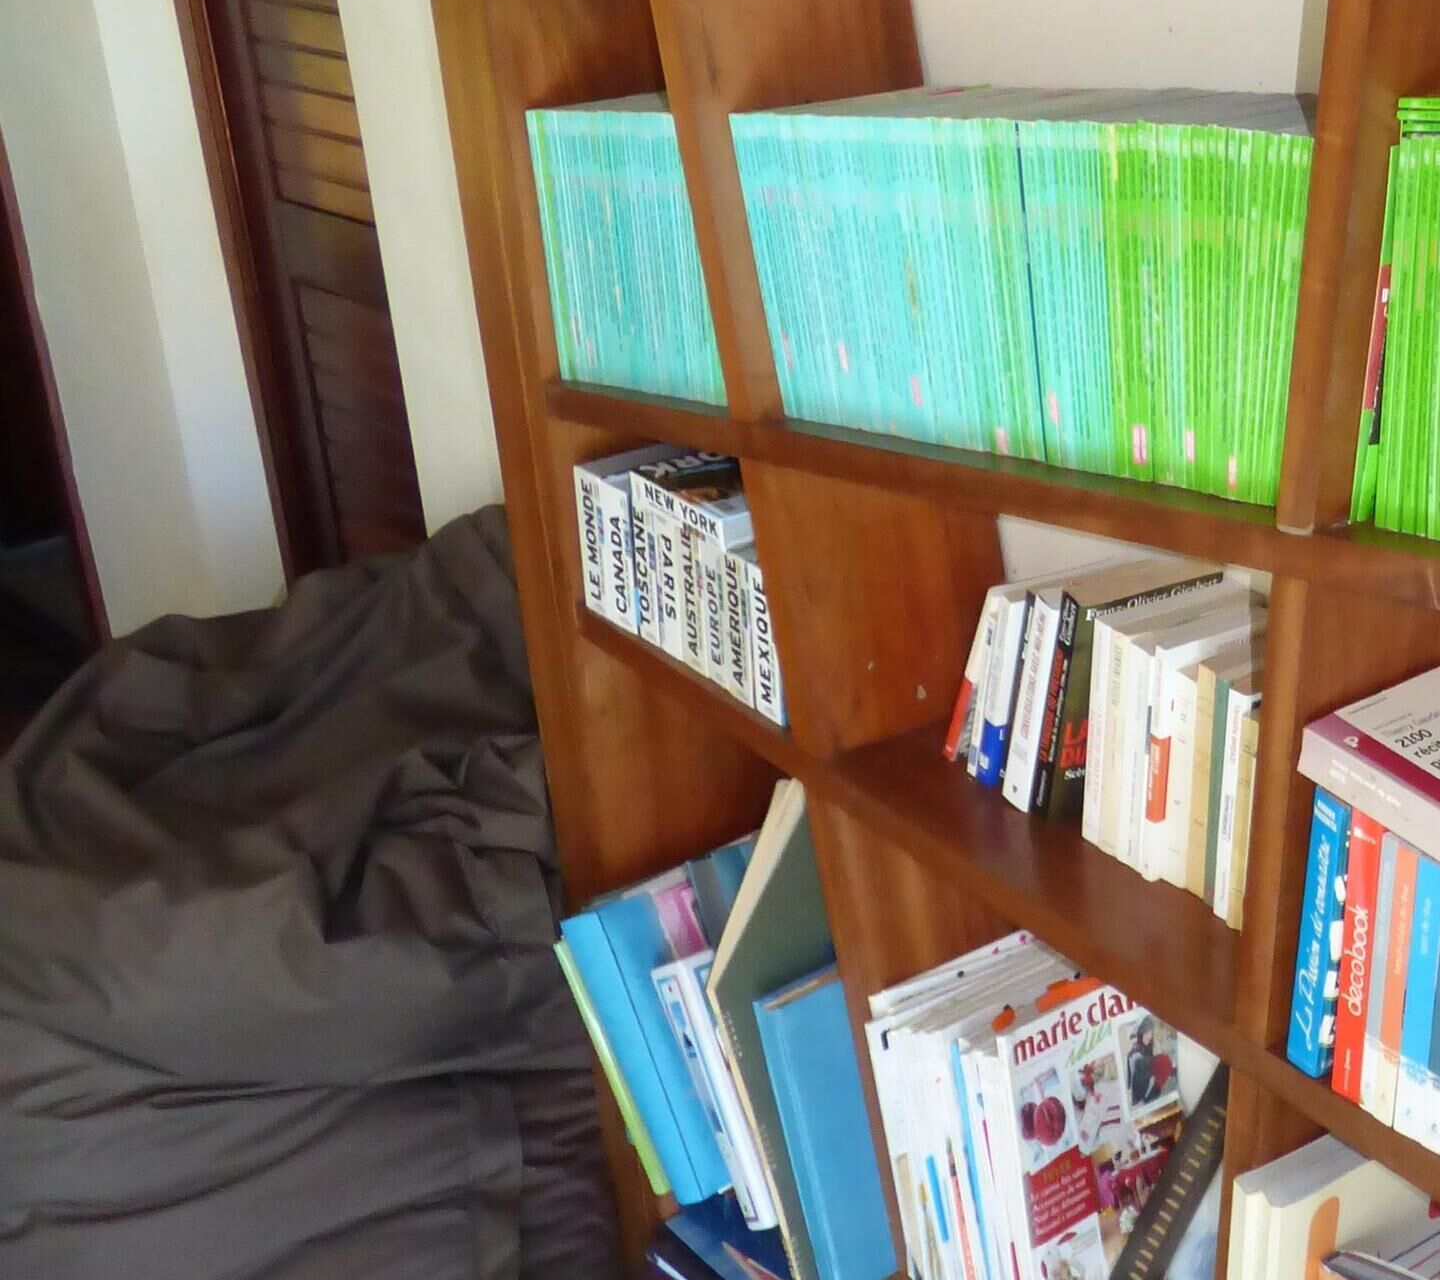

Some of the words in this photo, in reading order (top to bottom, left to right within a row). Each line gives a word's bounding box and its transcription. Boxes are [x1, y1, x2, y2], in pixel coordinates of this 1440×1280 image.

[580, 478, 599, 566] MONDE
[643, 482, 675, 512] NEW
[678, 506, 720, 540] YORK
[589, 570, 602, 601] LE
[609, 515, 629, 616] CANADA
[631, 506, 652, 626] TOSCANE
[661, 534, 677, 620] PARIS
[680, 521, 699, 658] AUSTRALIE
[704, 565, 722, 666] EUROPE
[724, 554, 746, 688] AMÉRIQUE
[752, 577, 773, 705] MEXIQUE
[1394, 728, 1433, 749] 2100
[1340, 903, 1369, 1017] decobook
[1013, 1010, 1082, 1066] marie
